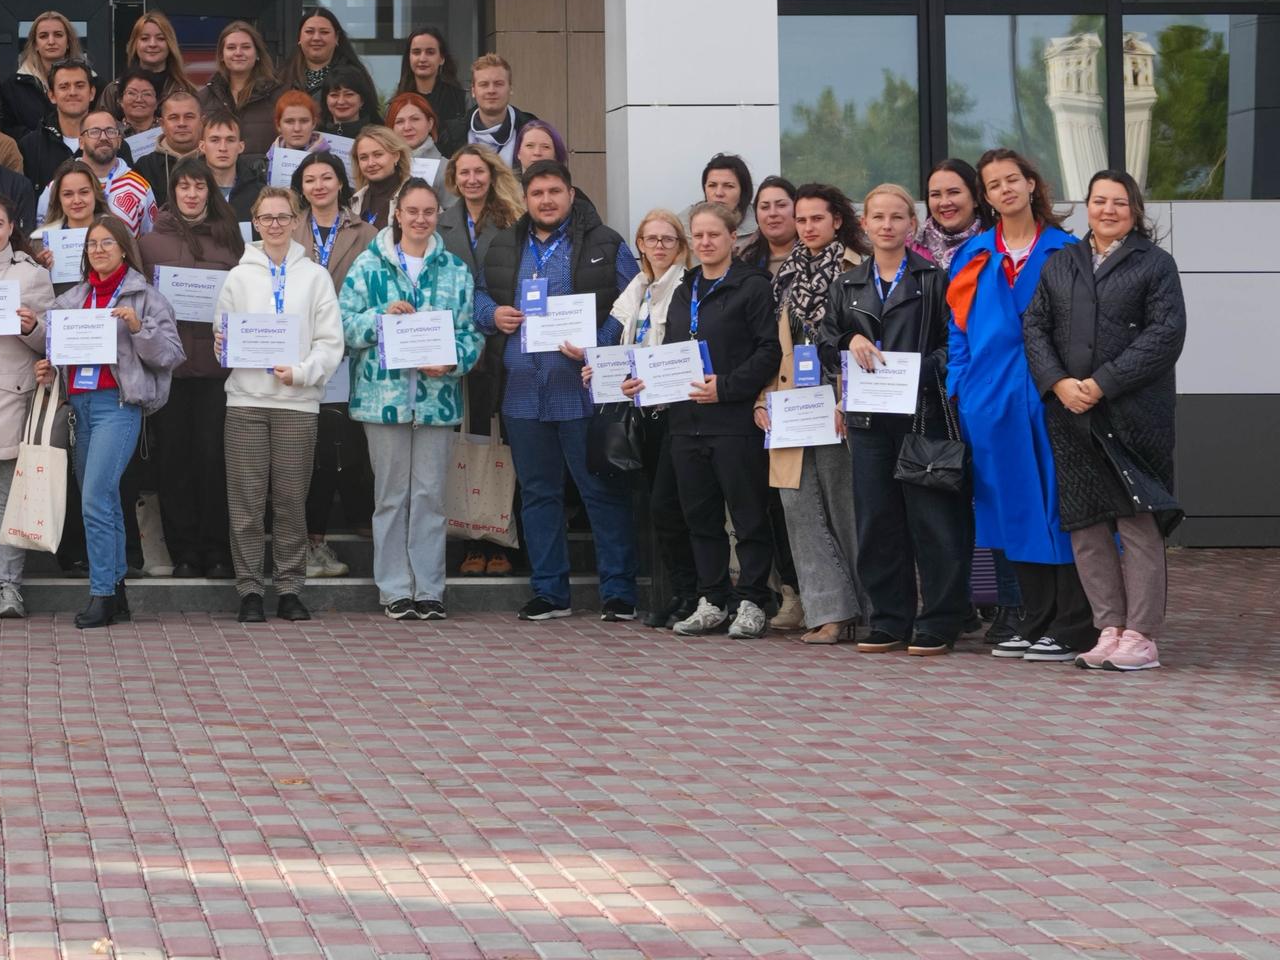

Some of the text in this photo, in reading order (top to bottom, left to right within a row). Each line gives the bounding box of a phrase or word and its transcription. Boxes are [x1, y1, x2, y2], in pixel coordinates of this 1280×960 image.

[171, 281, 216, 289] СЕРТИФИКАТ
[448, 520, 509, 534] СВЕТ ВНУТРИ
